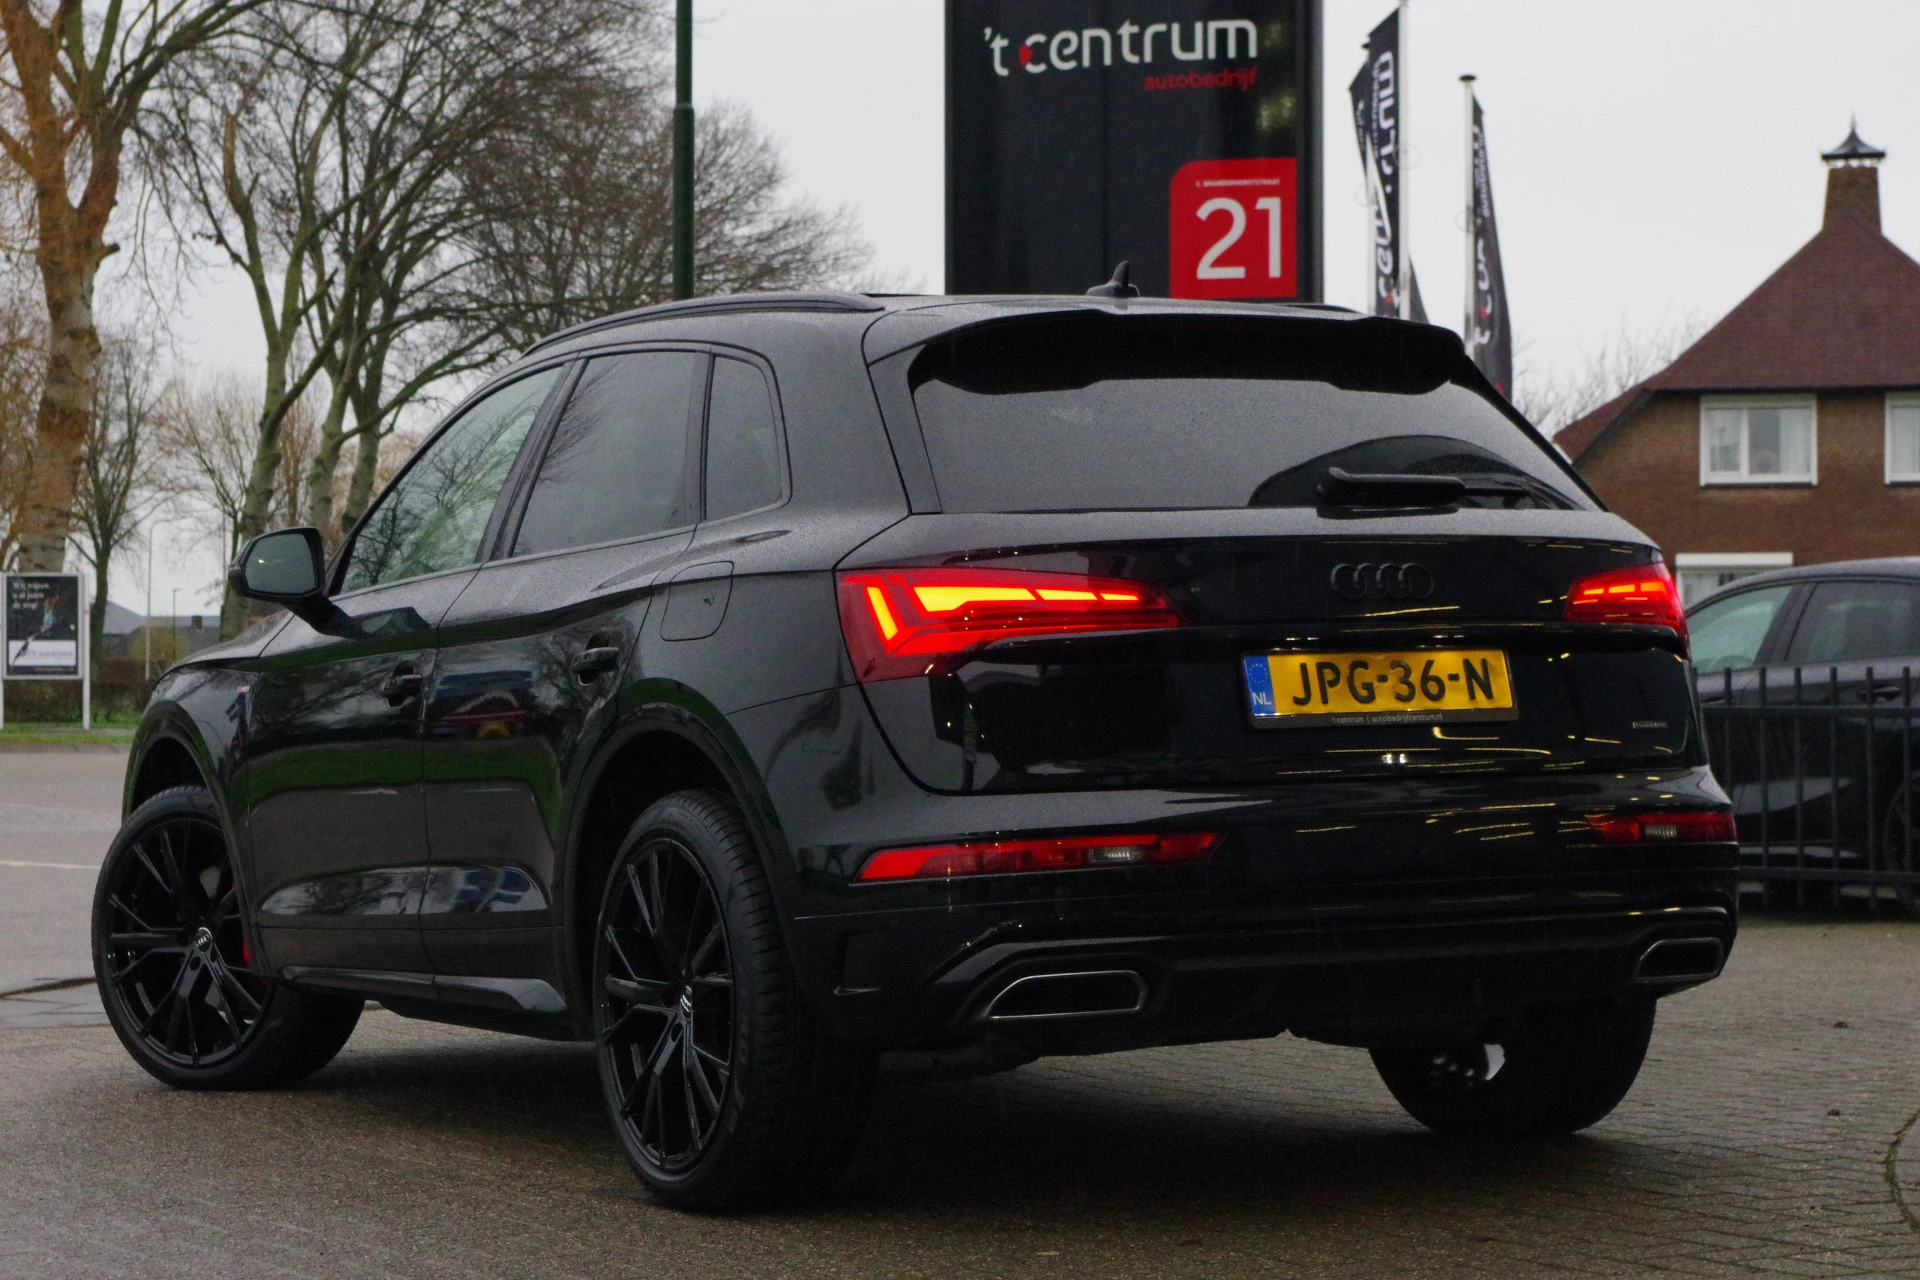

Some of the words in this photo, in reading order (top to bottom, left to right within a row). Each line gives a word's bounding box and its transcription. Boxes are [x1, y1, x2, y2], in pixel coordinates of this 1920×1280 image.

[1018, 19, 1258, 74] centrum
[1143, 66, 1259, 92] autobedrijf
[1195, 196, 1282, 280] 21
[1252, 692, 1272, 707] NL
[1293, 658, 1494, 705] JPG-36-N
[1371, 713, 1443, 724] autobedrijfcentrum.nl
